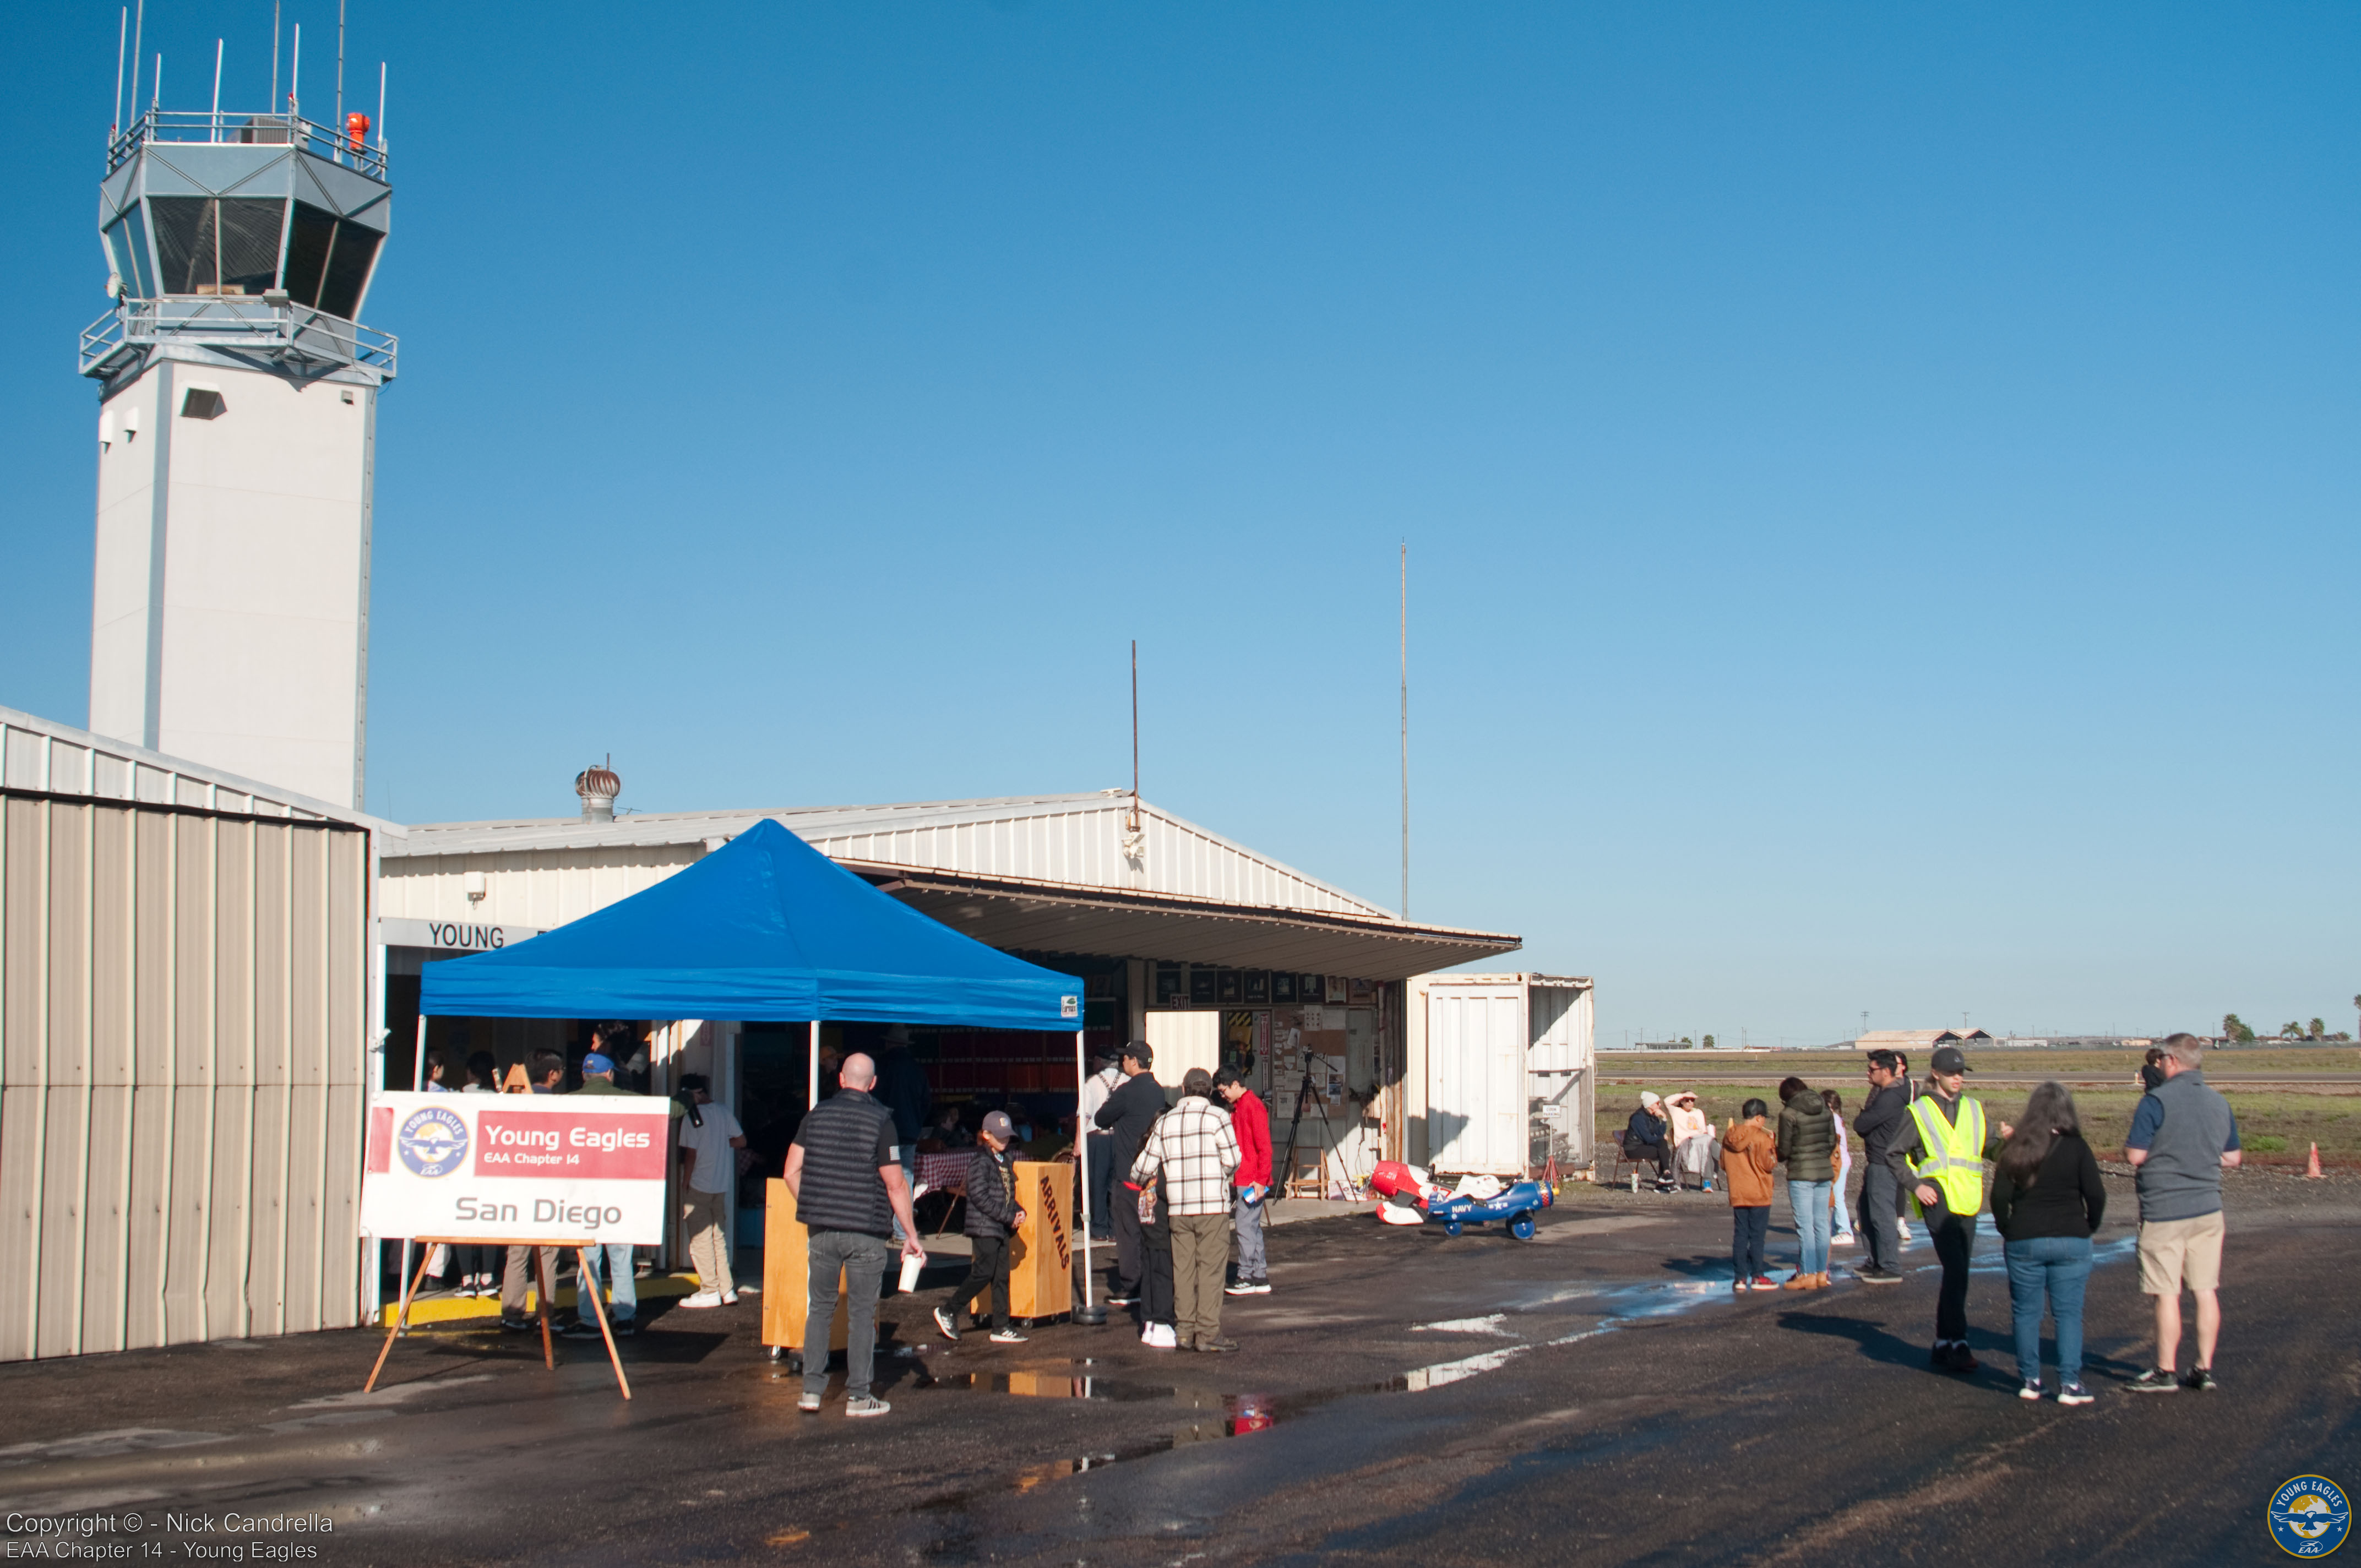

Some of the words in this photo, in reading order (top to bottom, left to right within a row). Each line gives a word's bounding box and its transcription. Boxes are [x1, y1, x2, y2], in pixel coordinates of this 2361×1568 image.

[429, 923, 503, 949] YOUNG
[1172, 995, 1189, 1010] EXIT
[405, 1110, 433, 1133] YOUNG
[436, 1110, 464, 1135] EAGLES
[485, 1125, 560, 1151] Young
[569, 1126, 650, 1152] Eagles
[483, 1152, 510, 1163] EAA
[514, 1153, 563, 1166] Chapter
[567, 1153, 580, 1164] 14
[1437, 1194, 1443, 1202] A
[1452, 1205, 1472, 1213] NAVY
[455, 1197, 518, 1222] San
[533, 1199, 622, 1230] Diego
[1040, 1175, 1069, 1270] ARRIVALS
